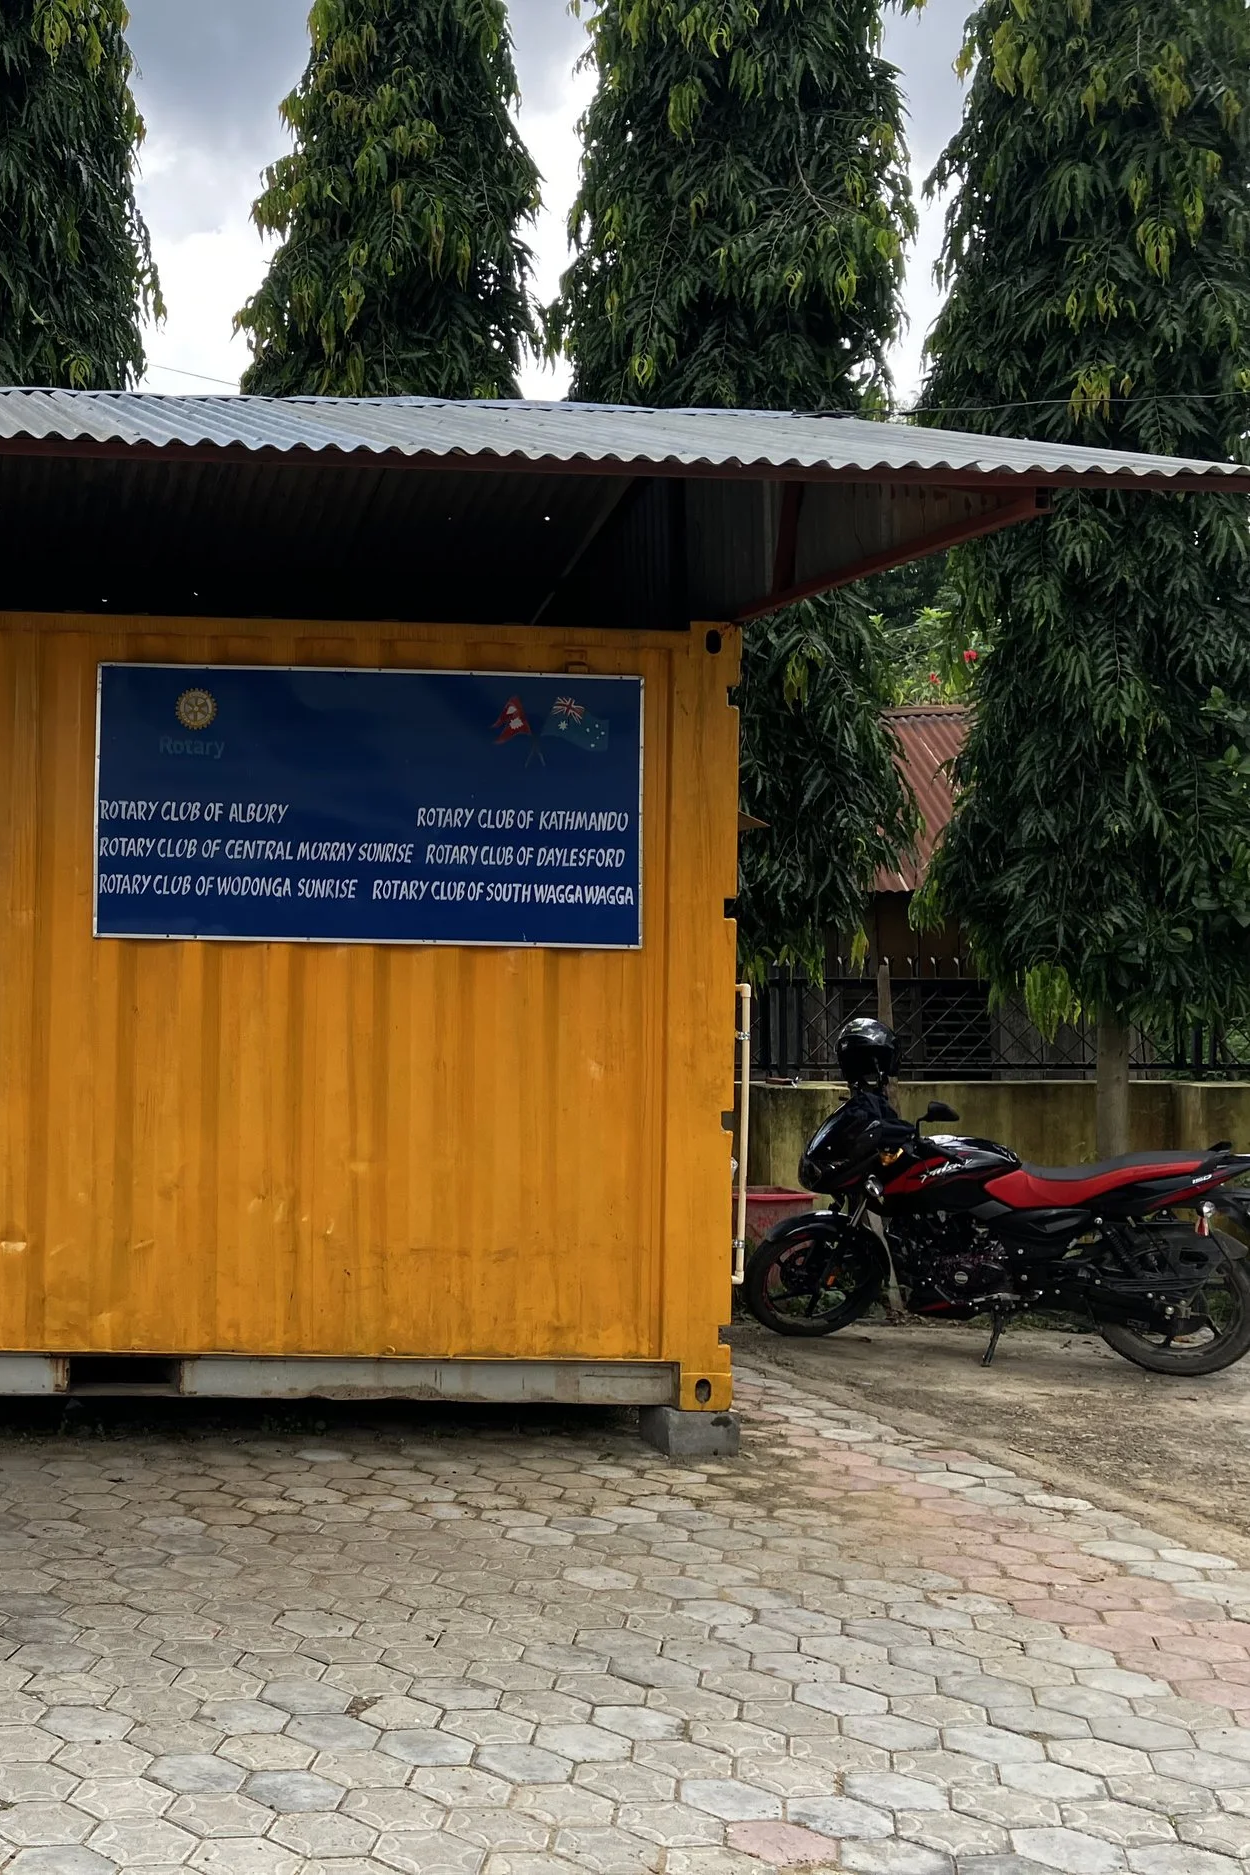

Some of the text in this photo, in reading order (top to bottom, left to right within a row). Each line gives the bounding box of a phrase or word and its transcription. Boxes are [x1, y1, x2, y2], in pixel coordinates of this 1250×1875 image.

[159, 736, 225, 759] Rotary
[99, 799, 289, 824] ROTARY CLUB OF ALBURY
[416, 807, 629, 832] ROTARY CLUB OF KATHMANDU
[99, 837, 415, 864] ROTARY CLUB OF CENTRAL MURRAY SUNRISE
[425, 844, 625, 868] ROTARY CLUB OF DAYLESFORD
[99, 873, 358, 899] ROTARY CLUB OF WODONGA SUNRISE
[372, 879, 634, 906] ROTARY CLUB OF SOUTH WAGGA WAGGA
